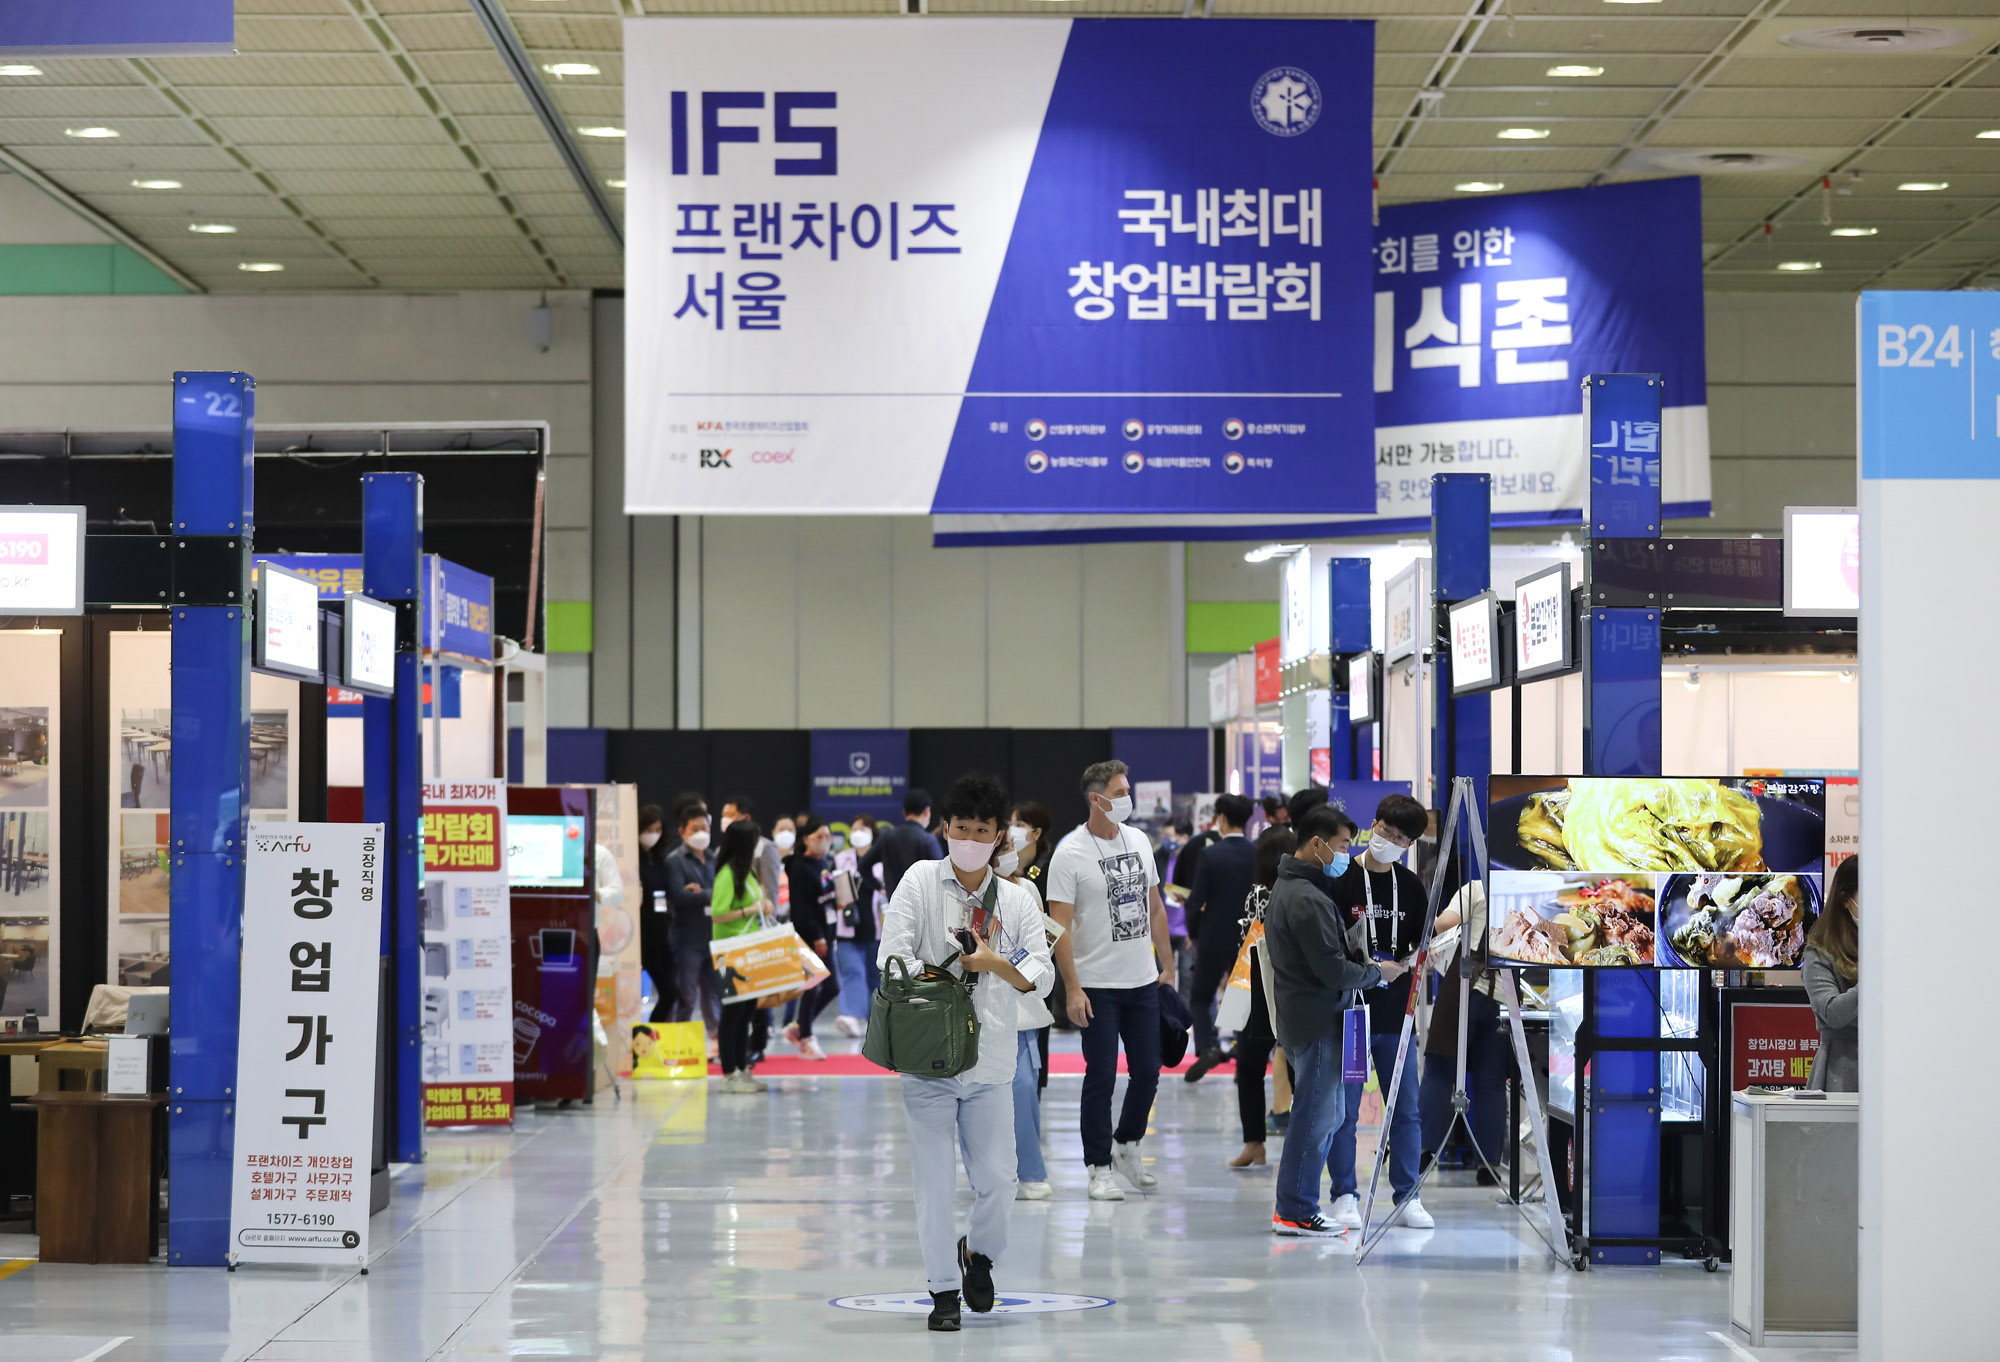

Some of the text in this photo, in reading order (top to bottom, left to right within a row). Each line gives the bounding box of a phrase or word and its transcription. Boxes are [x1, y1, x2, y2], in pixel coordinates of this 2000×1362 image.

[671, 91, 838, 176] IFS
[1118, 188, 1322, 247] 국내최대
[672, 202, 962, 262] 프랜차이즈
[1373, 226, 1515, 274] 회를 위한
[1067, 261, 1321, 321] 창업박람회
[673, 272, 787, 331] 서울
[1878, 324, 1964, 368] B24
[697, 421, 723, 432] KFA
[700, 448, 733, 469] RX
[752, 448, 795, 464] coex
[1420, 437, 1519, 463] 가능합니다.
[450, 784, 496, 800] 최저가!
[424, 812, 494, 843] 박람회
[271, 835, 311, 853] Arfu
[1829, 835, 1851, 845] 소자본
[424, 845, 494, 866] 특가판매
[361, 836, 376, 902] 공장직영
[1112, 885, 1144, 898] adidas
[282, 867, 340, 1140] 창업가구
[514, 1000, 558, 1028] cocopa
[1747, 1038, 1797, 1051] 창업시장의
[1747, 1058, 1786, 1078] 감자탕
[426, 1087, 502, 1104] 박람회 특가로
[470, 1103, 511, 1120] 최소화!
[246, 1154, 353, 1169] 프랜차이즈 개인창업
[251, 1171, 353, 1186] 호텔가구 사무가구
[250, 1188, 353, 1203] 설계가구 주문제작
[266, 1213, 335, 1226] 1577-6190
[263, 1234, 286, 1242] 홈페이지
[288, 1235, 340, 1244] www.arfu.co.kr
